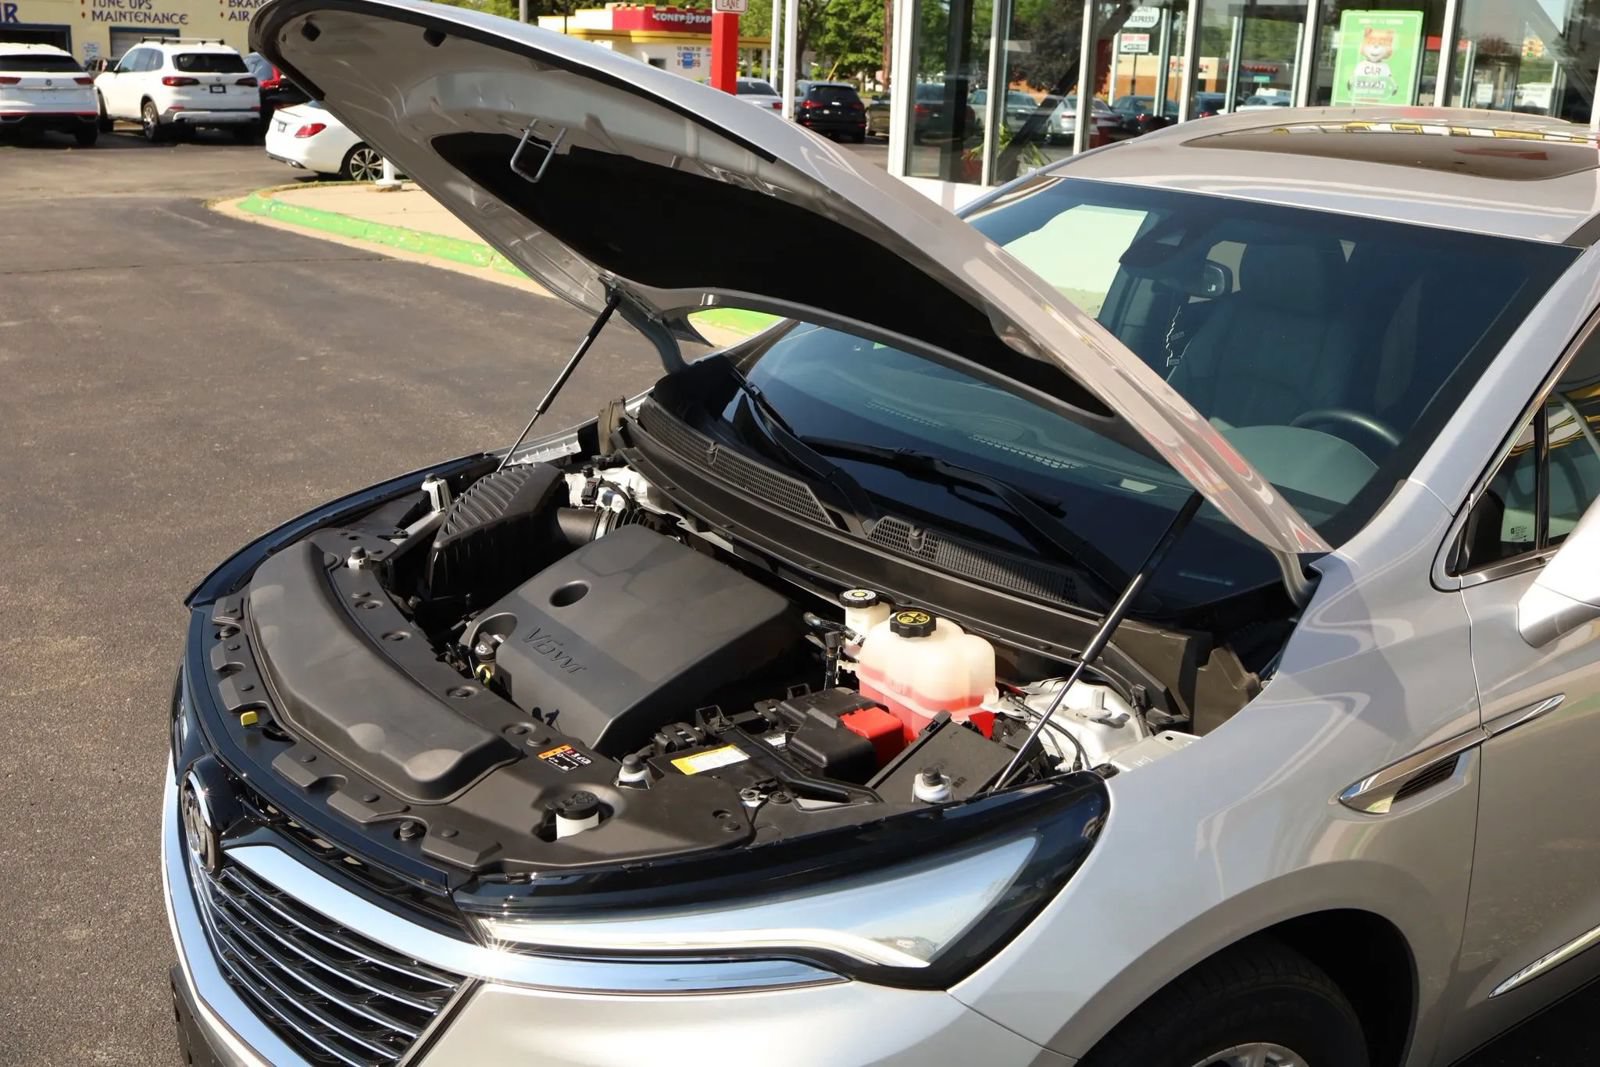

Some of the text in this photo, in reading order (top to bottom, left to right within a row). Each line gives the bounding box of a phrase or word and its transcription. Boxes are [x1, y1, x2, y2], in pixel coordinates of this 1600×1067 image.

[92, 0, 153, 9] TUNE UPS
[721, 0, 740, 8] LANE
[92, 10, 189, 25] MAINTENANCE
[228, 10, 250, 21] AIR
